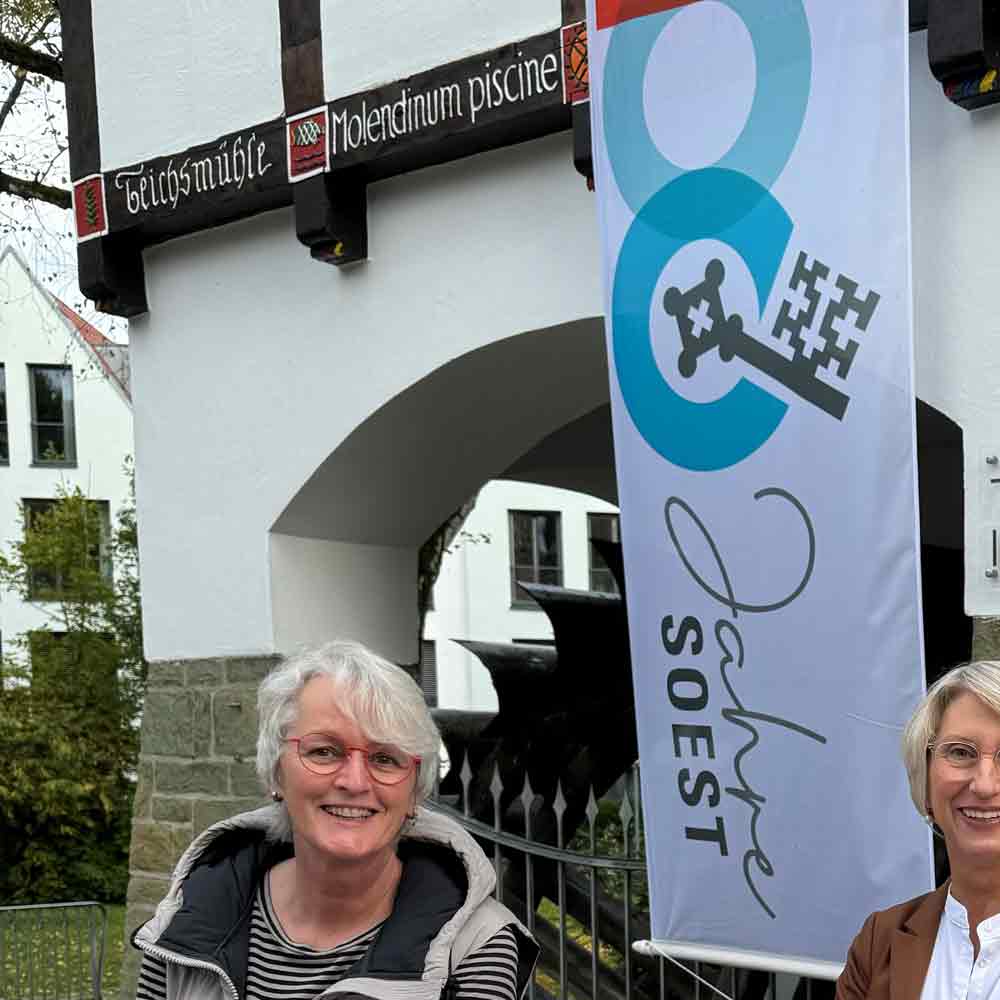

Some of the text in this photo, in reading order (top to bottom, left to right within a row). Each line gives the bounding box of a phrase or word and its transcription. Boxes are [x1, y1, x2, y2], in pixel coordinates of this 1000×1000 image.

[331, 52, 558, 154] Molendinum piscine
[662, 614, 729, 857] SOEST
